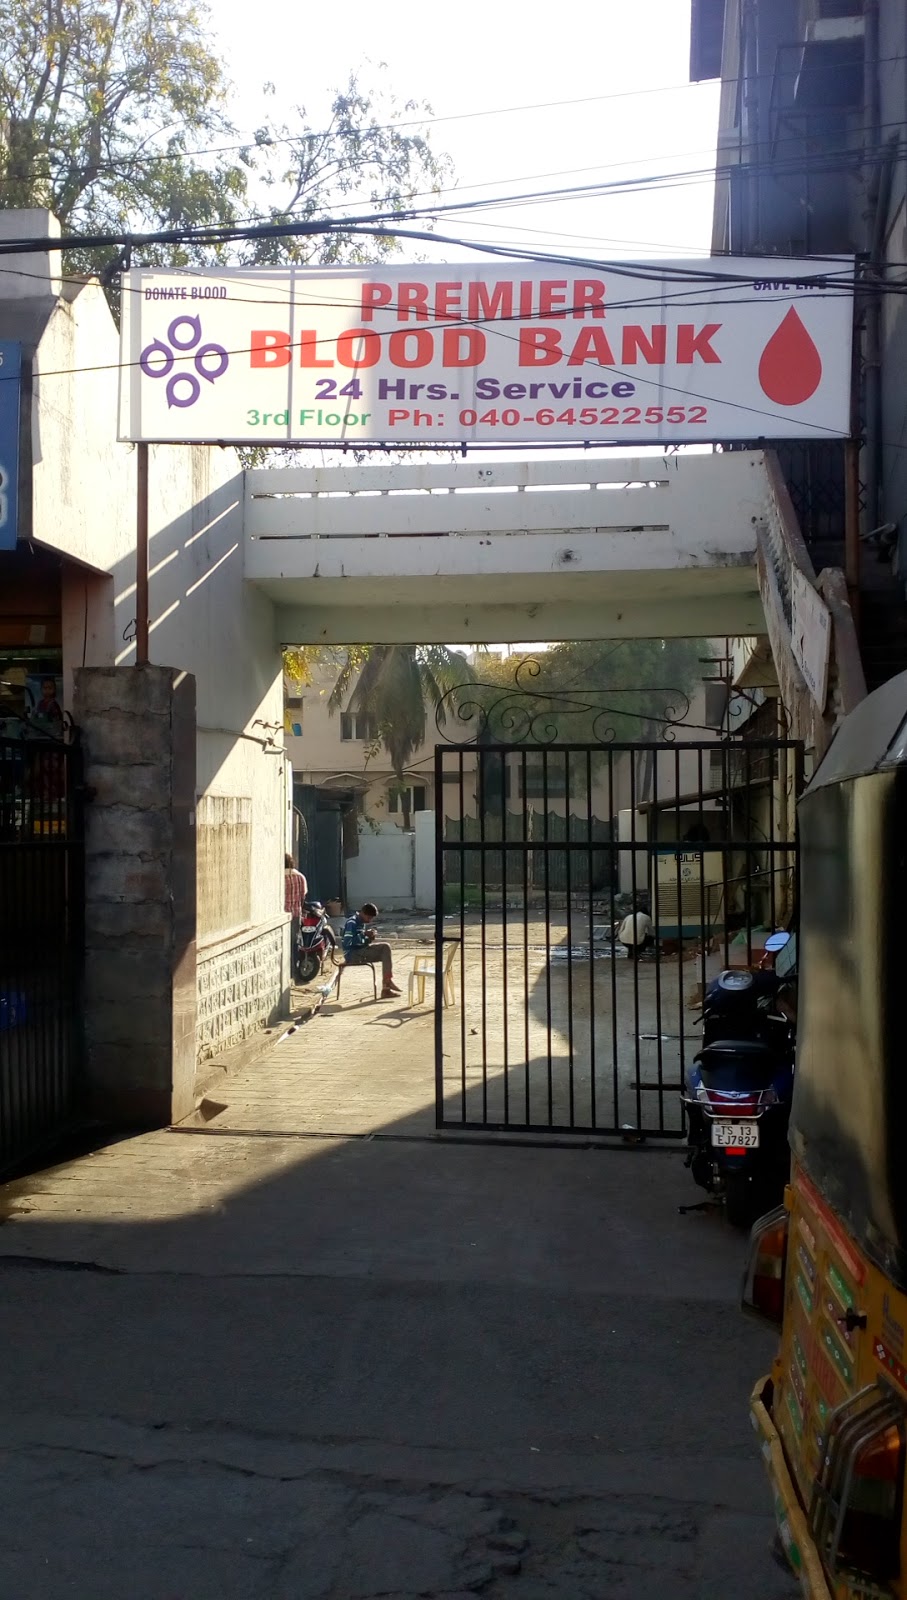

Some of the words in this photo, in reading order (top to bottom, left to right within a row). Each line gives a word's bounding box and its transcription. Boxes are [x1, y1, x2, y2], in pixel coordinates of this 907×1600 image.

[796, 278, 828, 290] LI
[145, 287, 187, 301] DONATE
[191, 286, 227, 300] BLOOD
[361, 280, 606, 322] PREMIER
[250, 328, 486, 369] BLOOD
[518, 323, 723, 367] BANK
[315, 379, 363, 400] 24
[378, 378, 459, 400] Hrs.
[475, 376, 636, 400] Service
[246, 409, 289, 426] 3rd
[299, 409, 371, 426] Floor
[388, 409, 445, 426] Ph:
[459, 405, 708, 426] 040-64522552
[721, 1126, 733, 1135] TS
[740, 1126, 751, 1135] 13
[717, 1135, 757, 1145] EJ7827
